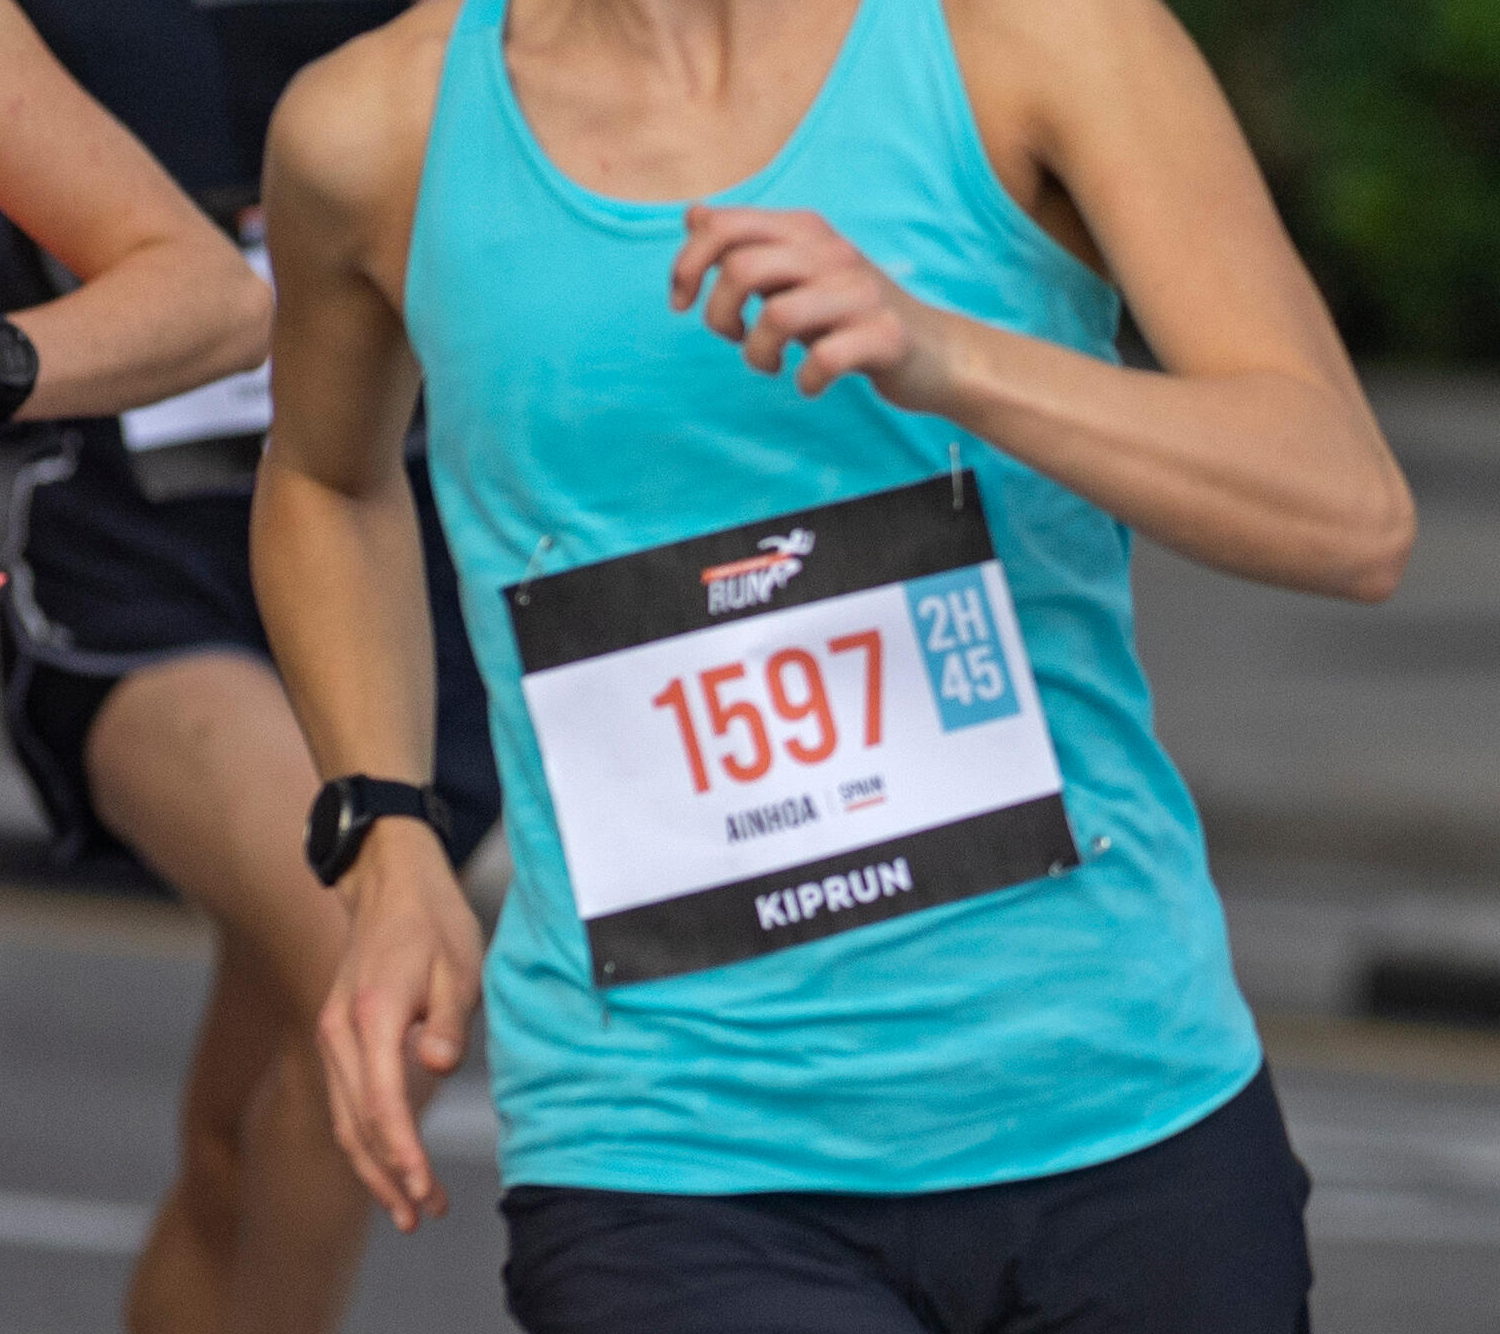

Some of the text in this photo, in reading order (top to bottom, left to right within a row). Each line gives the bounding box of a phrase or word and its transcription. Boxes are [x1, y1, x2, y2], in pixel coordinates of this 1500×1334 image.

[707, 570, 770, 616] RUN
[919, 587, 987, 652] 2H
[940, 645, 1002, 705] 45
[652, 629, 884, 794] 1597
[755, 858, 912, 930] KIPRUN
